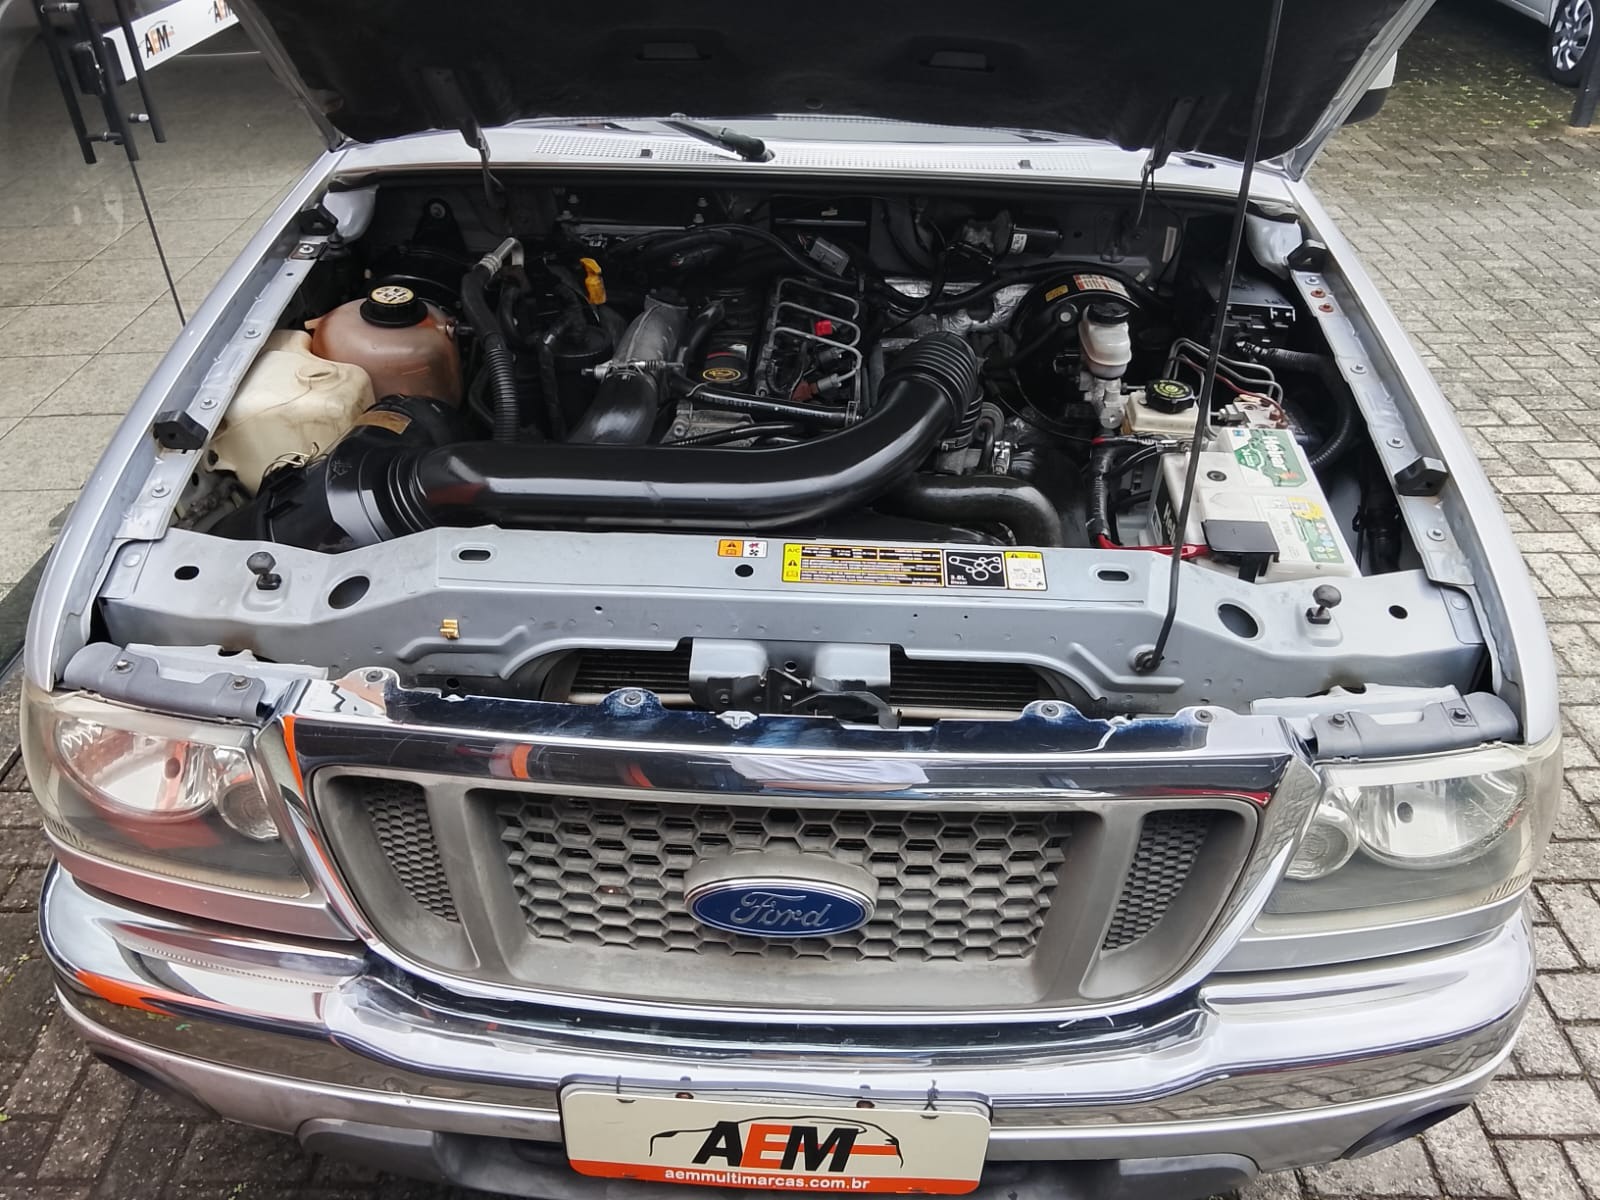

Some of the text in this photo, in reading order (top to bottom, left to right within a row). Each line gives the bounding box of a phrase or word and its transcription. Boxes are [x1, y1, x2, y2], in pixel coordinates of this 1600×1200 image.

[145, 24, 170, 58] AEM
[1261, 435, 1290, 472] Heliar
[729, 891, 833, 928] Ford
[691, 1120, 859, 1173] AEM
[664, 1168, 871, 1190] aemmultimarcas.com.br
